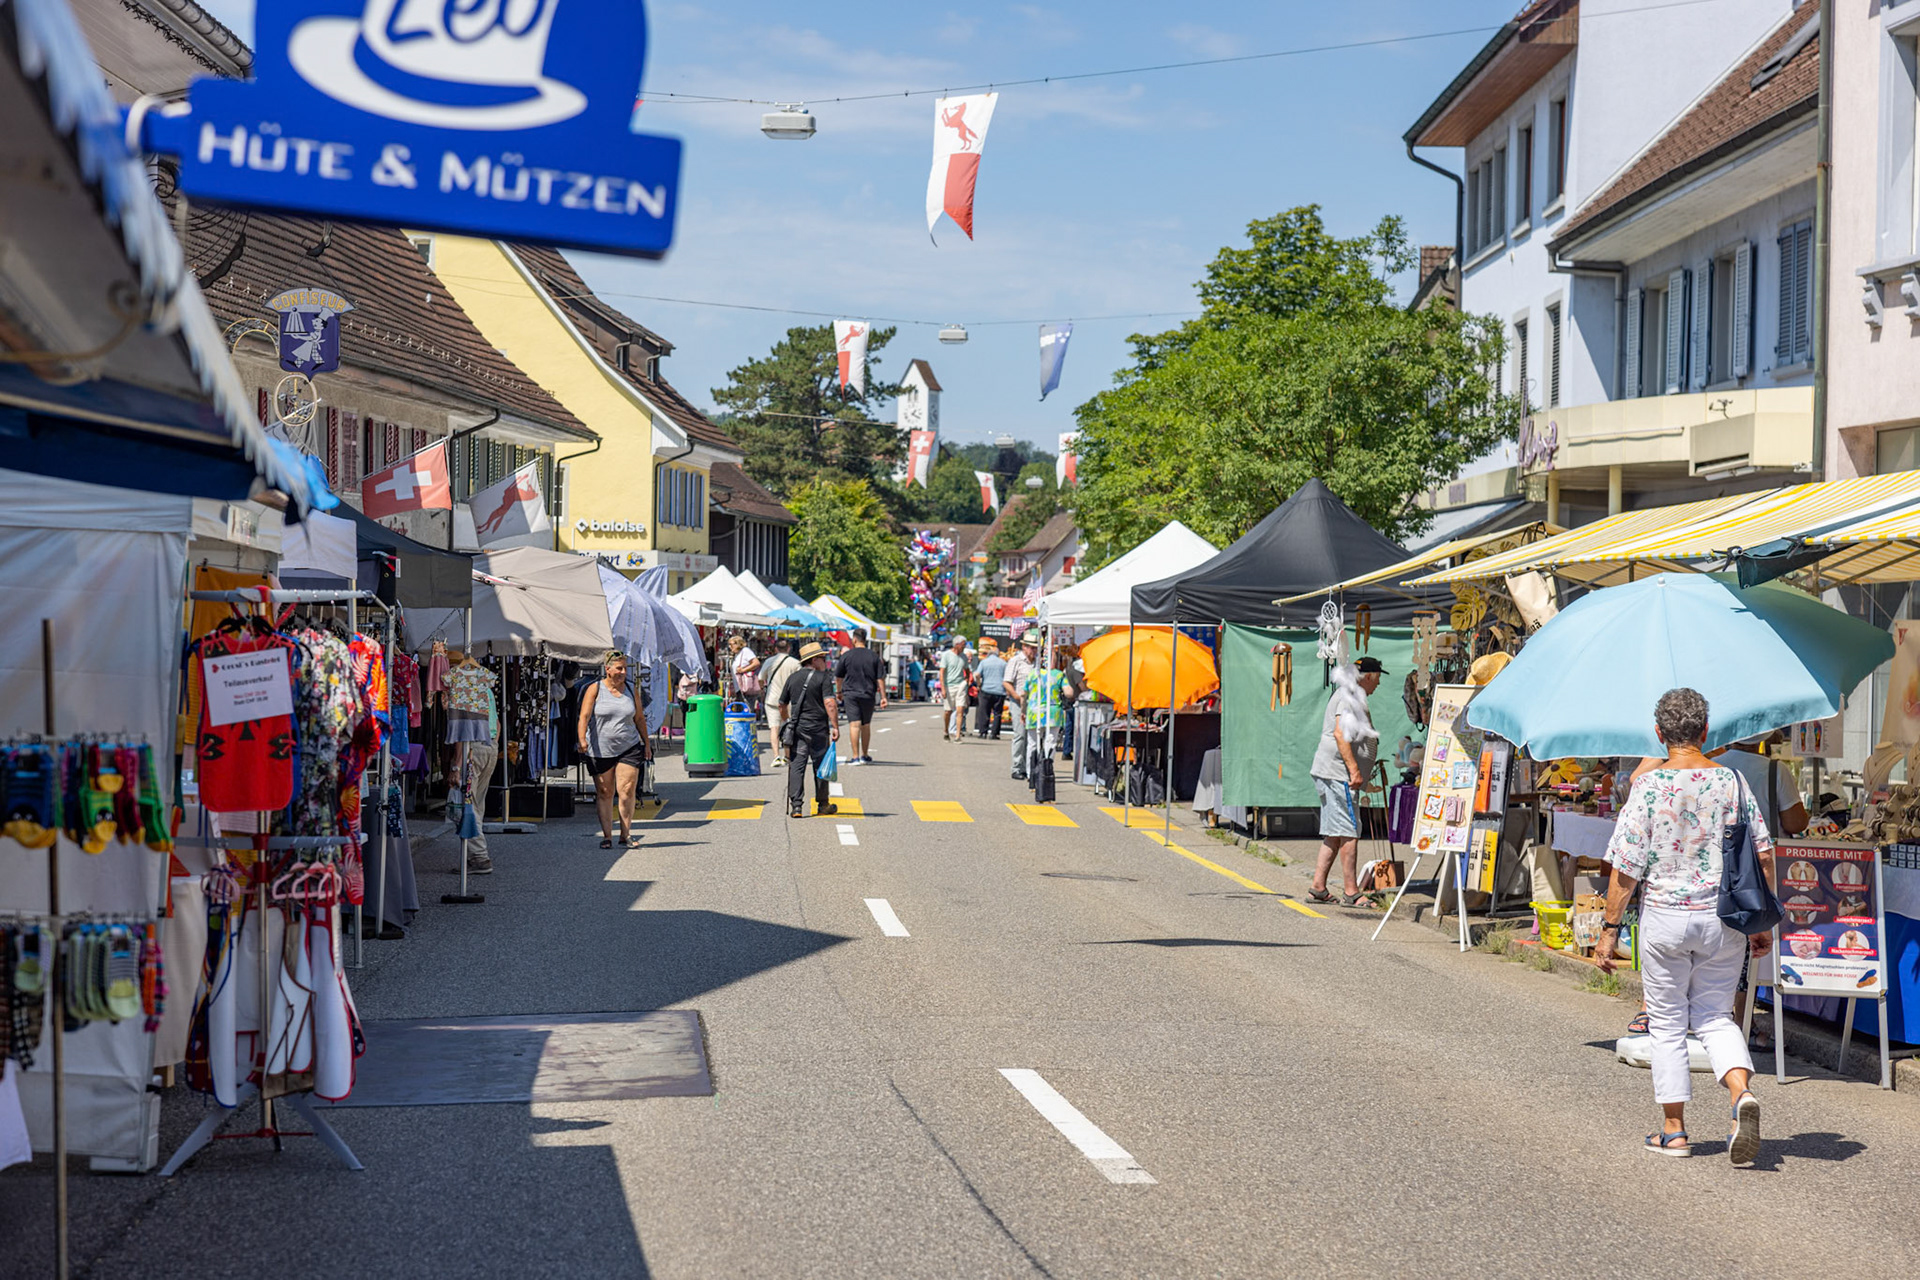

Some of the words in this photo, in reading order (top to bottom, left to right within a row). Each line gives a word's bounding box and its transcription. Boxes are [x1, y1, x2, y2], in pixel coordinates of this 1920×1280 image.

[199, 121, 355, 180] HÜTE
[371, 143, 418, 189] &
[439, 151, 667, 218] MÜTZEN
[271, 291, 346, 312] CONFISEUR
[590, 518, 645, 533] baloise
[1785, 848, 1841, 859] PROBLEME
[1843, 850, 1863, 860] MIT
